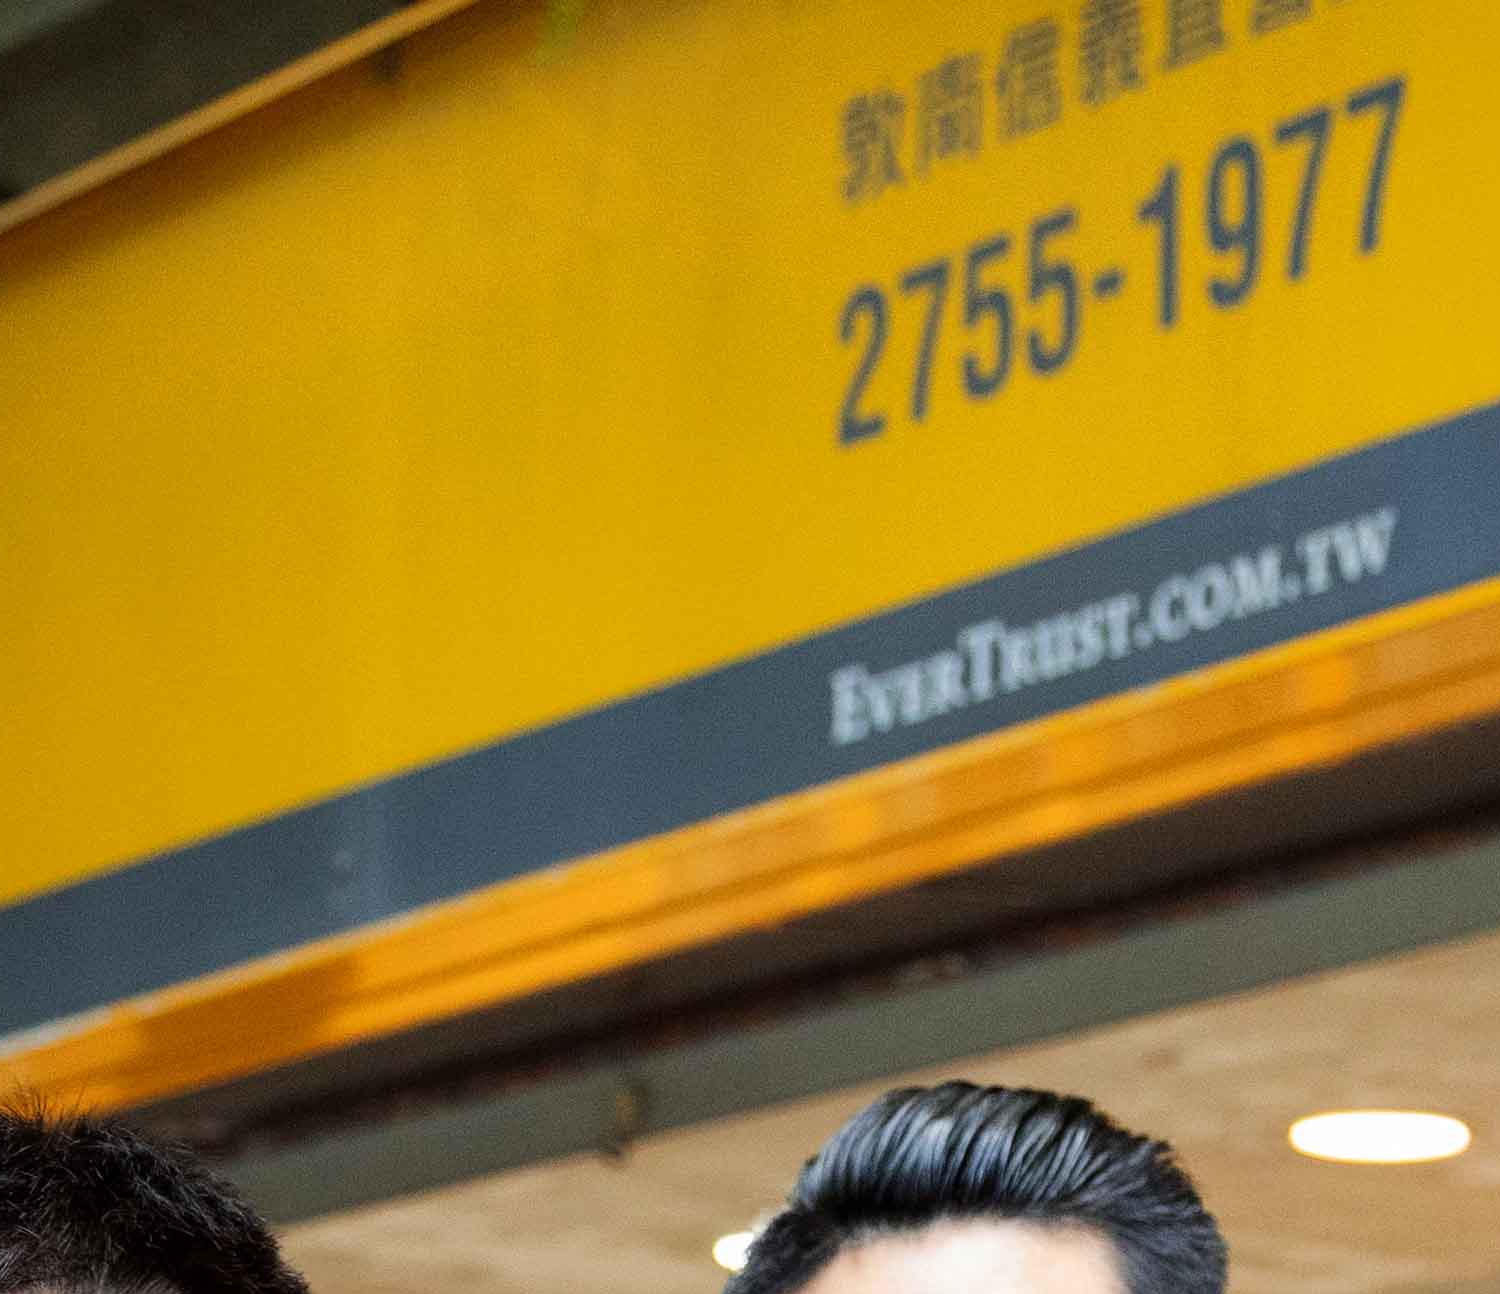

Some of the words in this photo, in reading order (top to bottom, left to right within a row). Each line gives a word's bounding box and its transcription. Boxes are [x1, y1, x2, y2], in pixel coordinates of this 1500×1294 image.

[839, 0, 1318, 206] 敦南信義直
[838, 74, 1406, 446] 2755-1977
